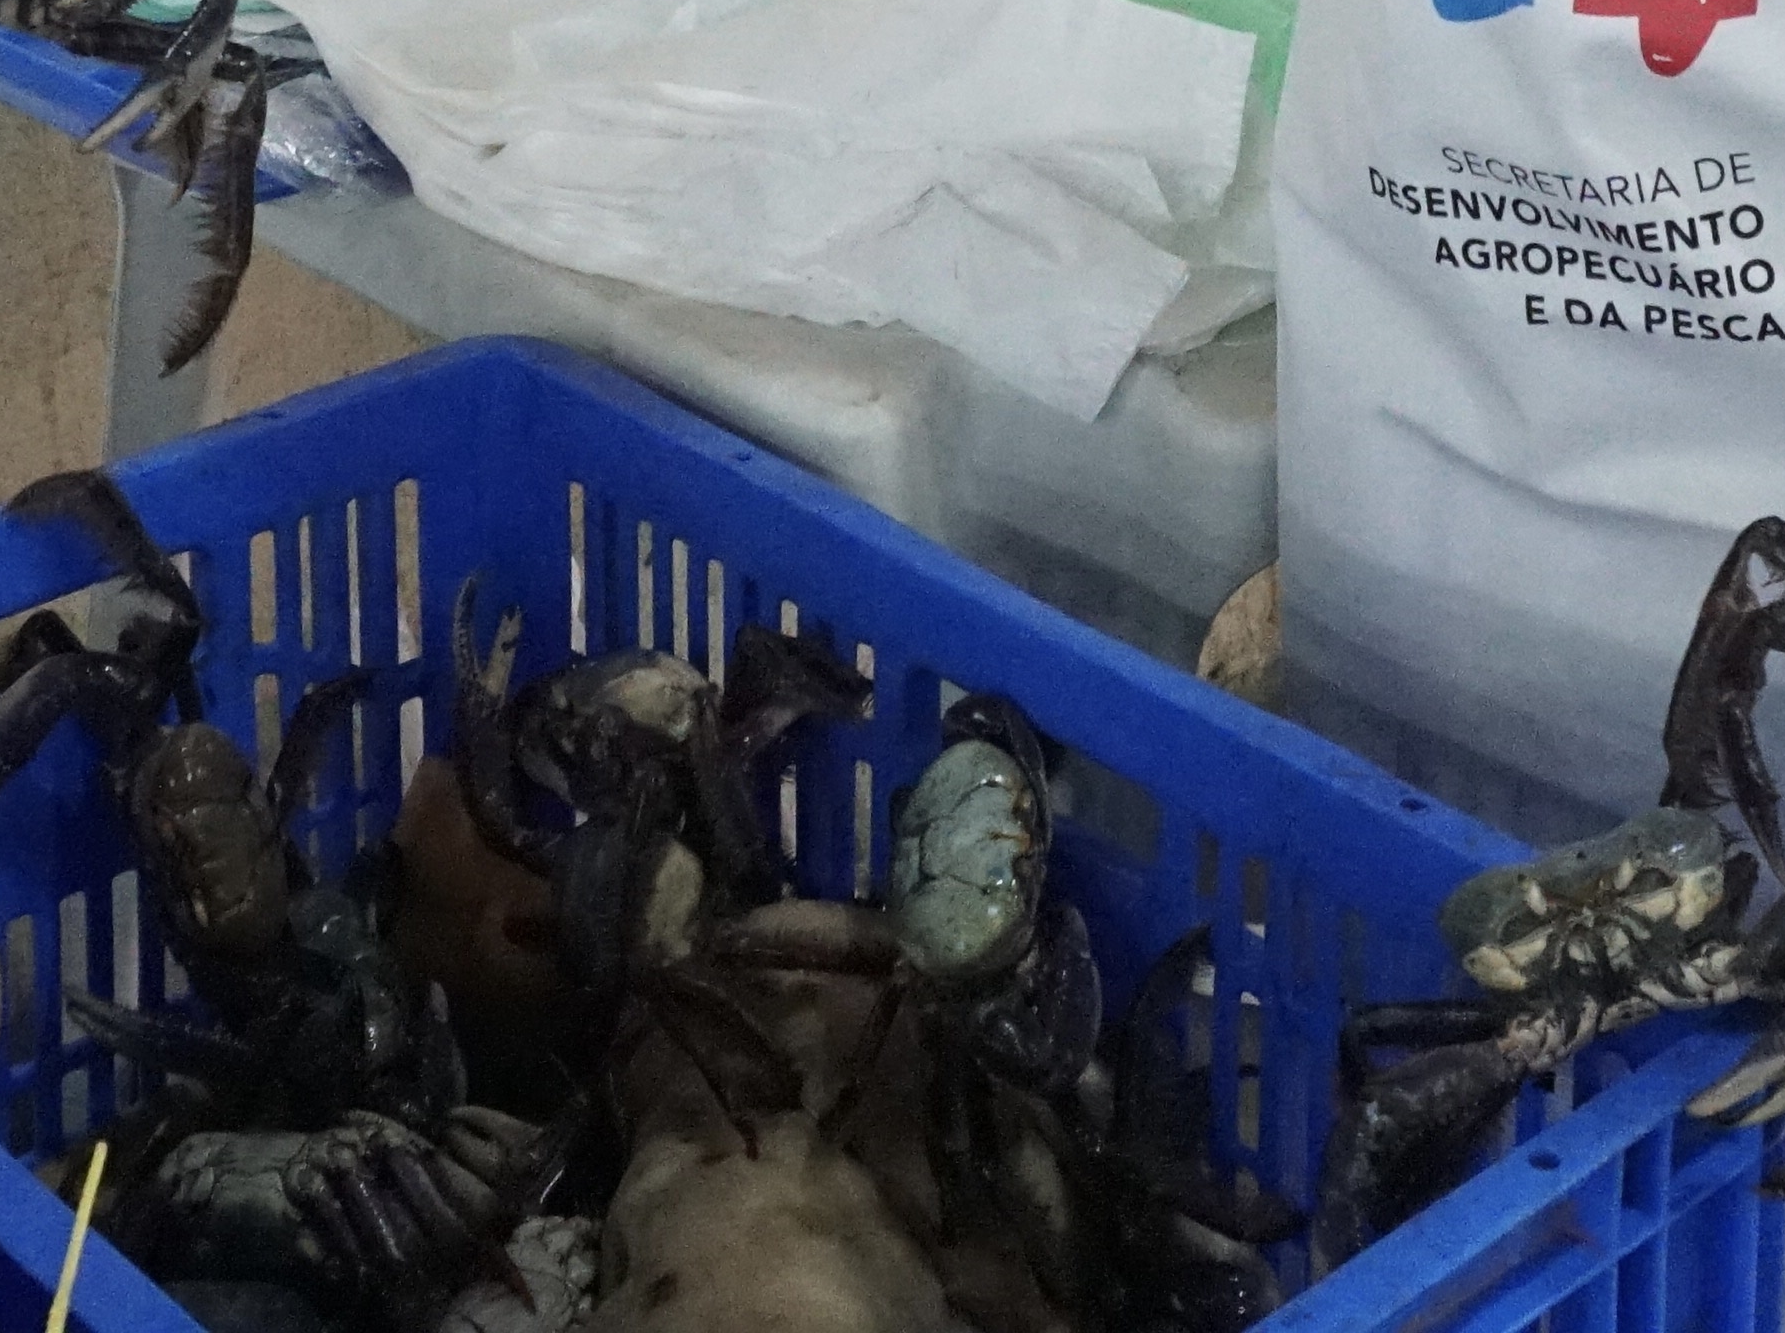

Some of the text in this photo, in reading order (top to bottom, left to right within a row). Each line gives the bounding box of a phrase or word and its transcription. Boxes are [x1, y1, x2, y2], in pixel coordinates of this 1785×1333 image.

[1441, 146, 1756, 207] SECRETARIA DE
[1368, 165, 1765, 254] DESENVOLVIMENTO
[1434, 236, 1776, 300] AGROPECUÁRIO
[1525, 294, 1550, 326] E
[1564, 298, 1628, 333] DA
